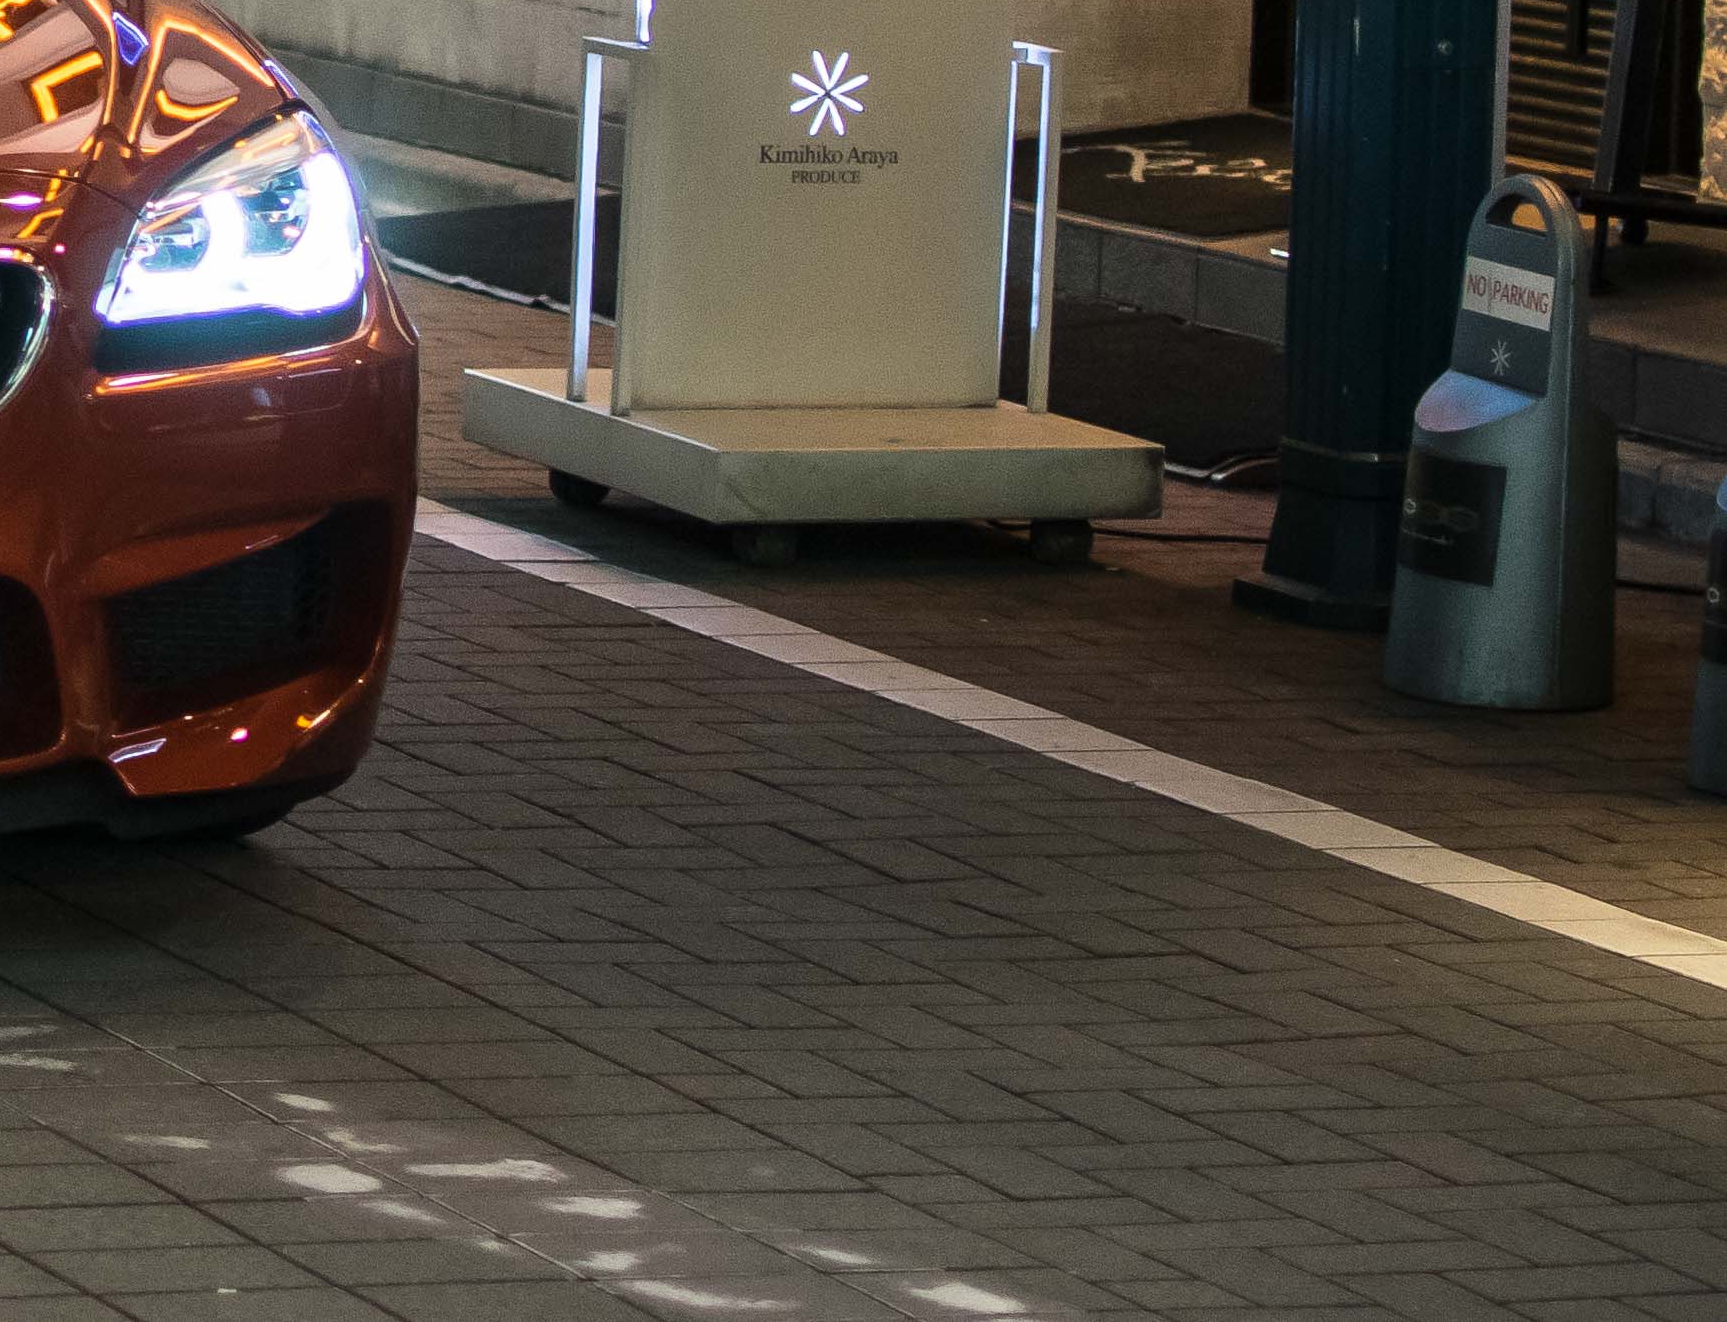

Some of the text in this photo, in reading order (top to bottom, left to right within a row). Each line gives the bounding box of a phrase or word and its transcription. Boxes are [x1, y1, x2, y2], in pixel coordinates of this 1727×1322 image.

[759, 144, 899, 169] Kimihiko Araya
[791, 170, 860, 184] PRODUCE
[1467, 276, 1549, 314] NO PARKING
